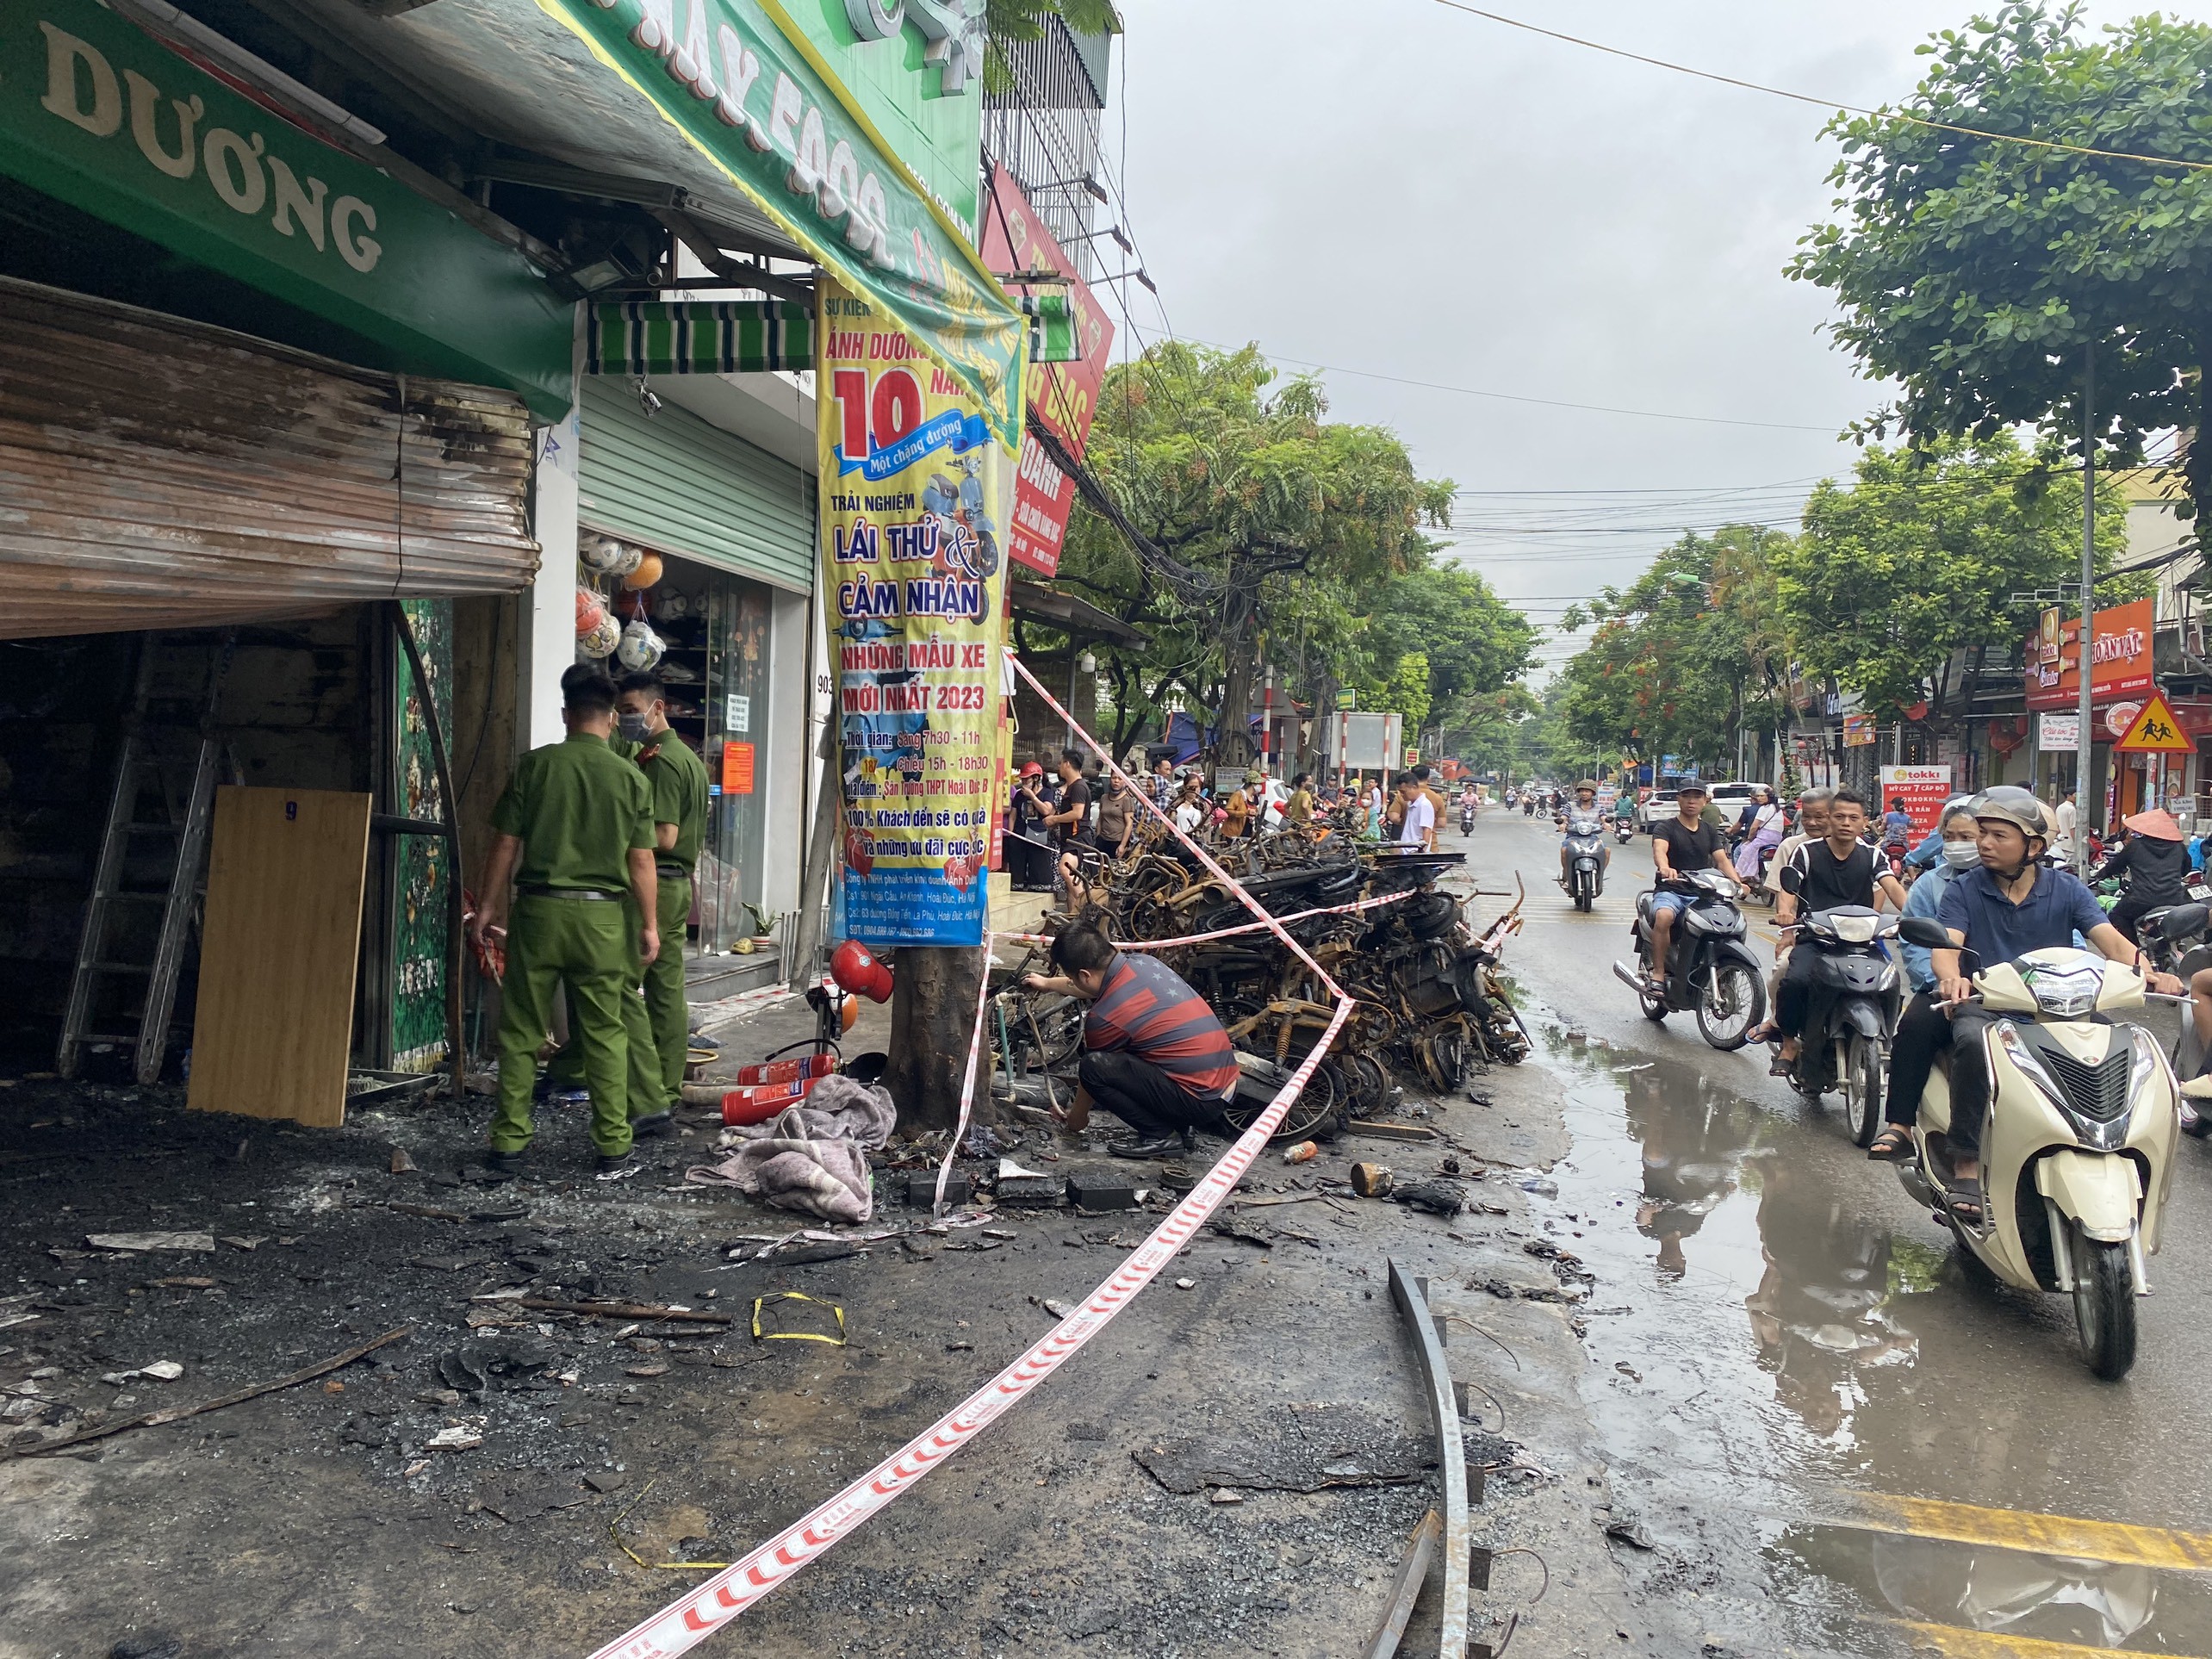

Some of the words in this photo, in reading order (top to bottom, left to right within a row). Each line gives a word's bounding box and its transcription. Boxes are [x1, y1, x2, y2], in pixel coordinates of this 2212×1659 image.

[39, 20, 382, 273] DƯƠNG
[824, 297, 841, 317] SỰ
[825, 326, 865, 359] ÁNH
[869, 331, 929, 361] DƯƠN
[834, 369, 922, 457] 10
[870, 455, 892, 475] Một
[893, 439, 925, 466] chặng
[926, 419, 962, 446] đường
[1021, 429, 1063, 502] OANH
[831, 490, 860, 512] TRẢI
[865, 491, 915, 513] NGHIỆM
[836, 519, 877, 561] LÁI
[886, 516, 940, 560] THỬ
[946, 525, 980, 579] &
[839, 575, 898, 616] CẢM
[907, 576, 979, 620] NHẬN
[841, 642, 904, 670] NHỮNG
[909, 634, 954, 668] MẪU
[960, 643, 985, 668] XE
[817, 674, 834, 694] 903
[842, 684, 879, 711] MỚI
[885, 677, 931, 711] NHẤT
[936, 686, 985, 710] 2023
[847, 730, 864, 746] Thời
[867, 731, 892, 748] gian:
[898, 730, 921, 749] Sáng
[923, 730, 949, 745] 7h30
[961, 730, 980, 745] 11h
[929, 756, 947, 770] 15h
[959, 755, 989, 769] 18h30
[884, 779, 898, 796] Sân
[926, 779, 946, 796] THPT
[948, 779, 967, 795] Hoài
[982, 778, 989, 793] B
[1935, 784, 1945, 792] ĐỘ
[877, 810, 910, 827] Khách
[913, 806, 933, 827] đến
[935, 806, 949, 826] sẽ
[954, 807, 968, 826] có
[863, 839, 875, 855] và
[877, 838, 907, 857] những
[925, 838, 944, 855] đãi
[948, 839, 969, 860] cực
[846, 873, 861, 885] Công
[867, 873, 883, 884] TNHH
